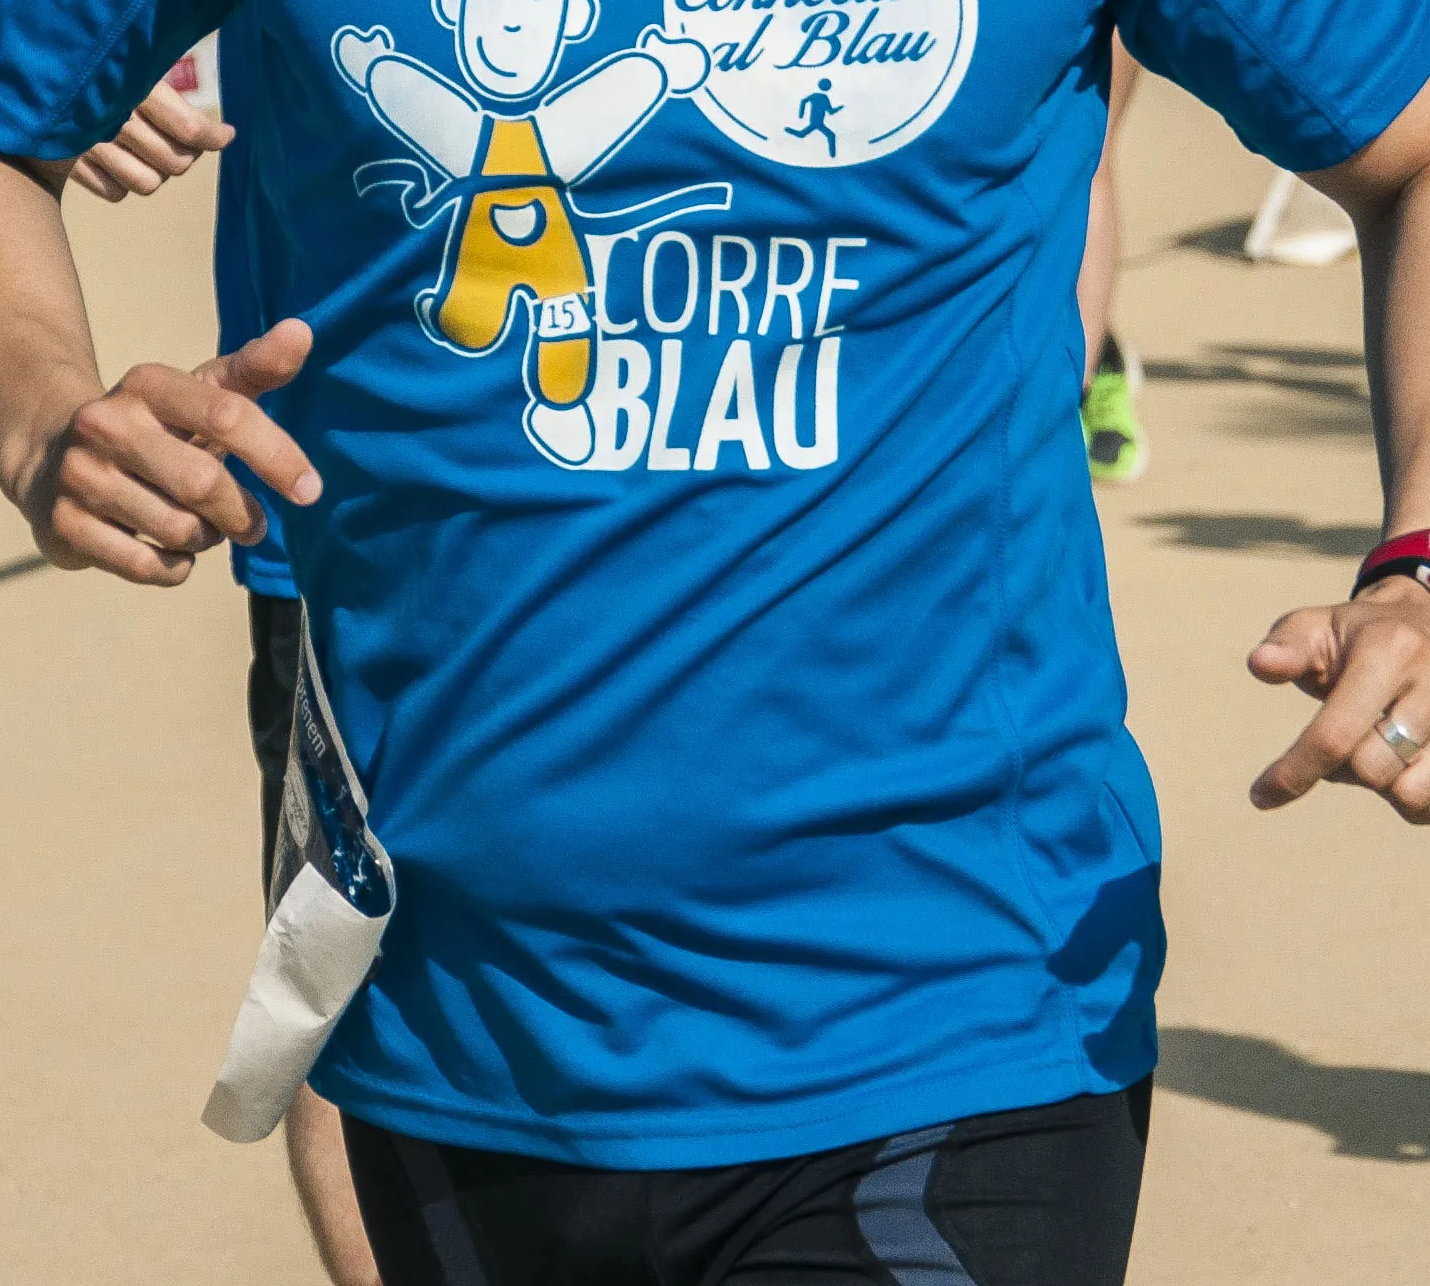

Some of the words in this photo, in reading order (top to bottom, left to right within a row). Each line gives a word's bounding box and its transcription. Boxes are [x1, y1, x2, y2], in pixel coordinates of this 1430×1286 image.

[711, 13, 775, 73] al
[772, 7, 938, 71] Blau
[543, 299, 577, 331] 15
[595, 230, 868, 341] CORRE
[591, 336, 842, 472] BLAU
[295, 676, 327, 760] prenem
